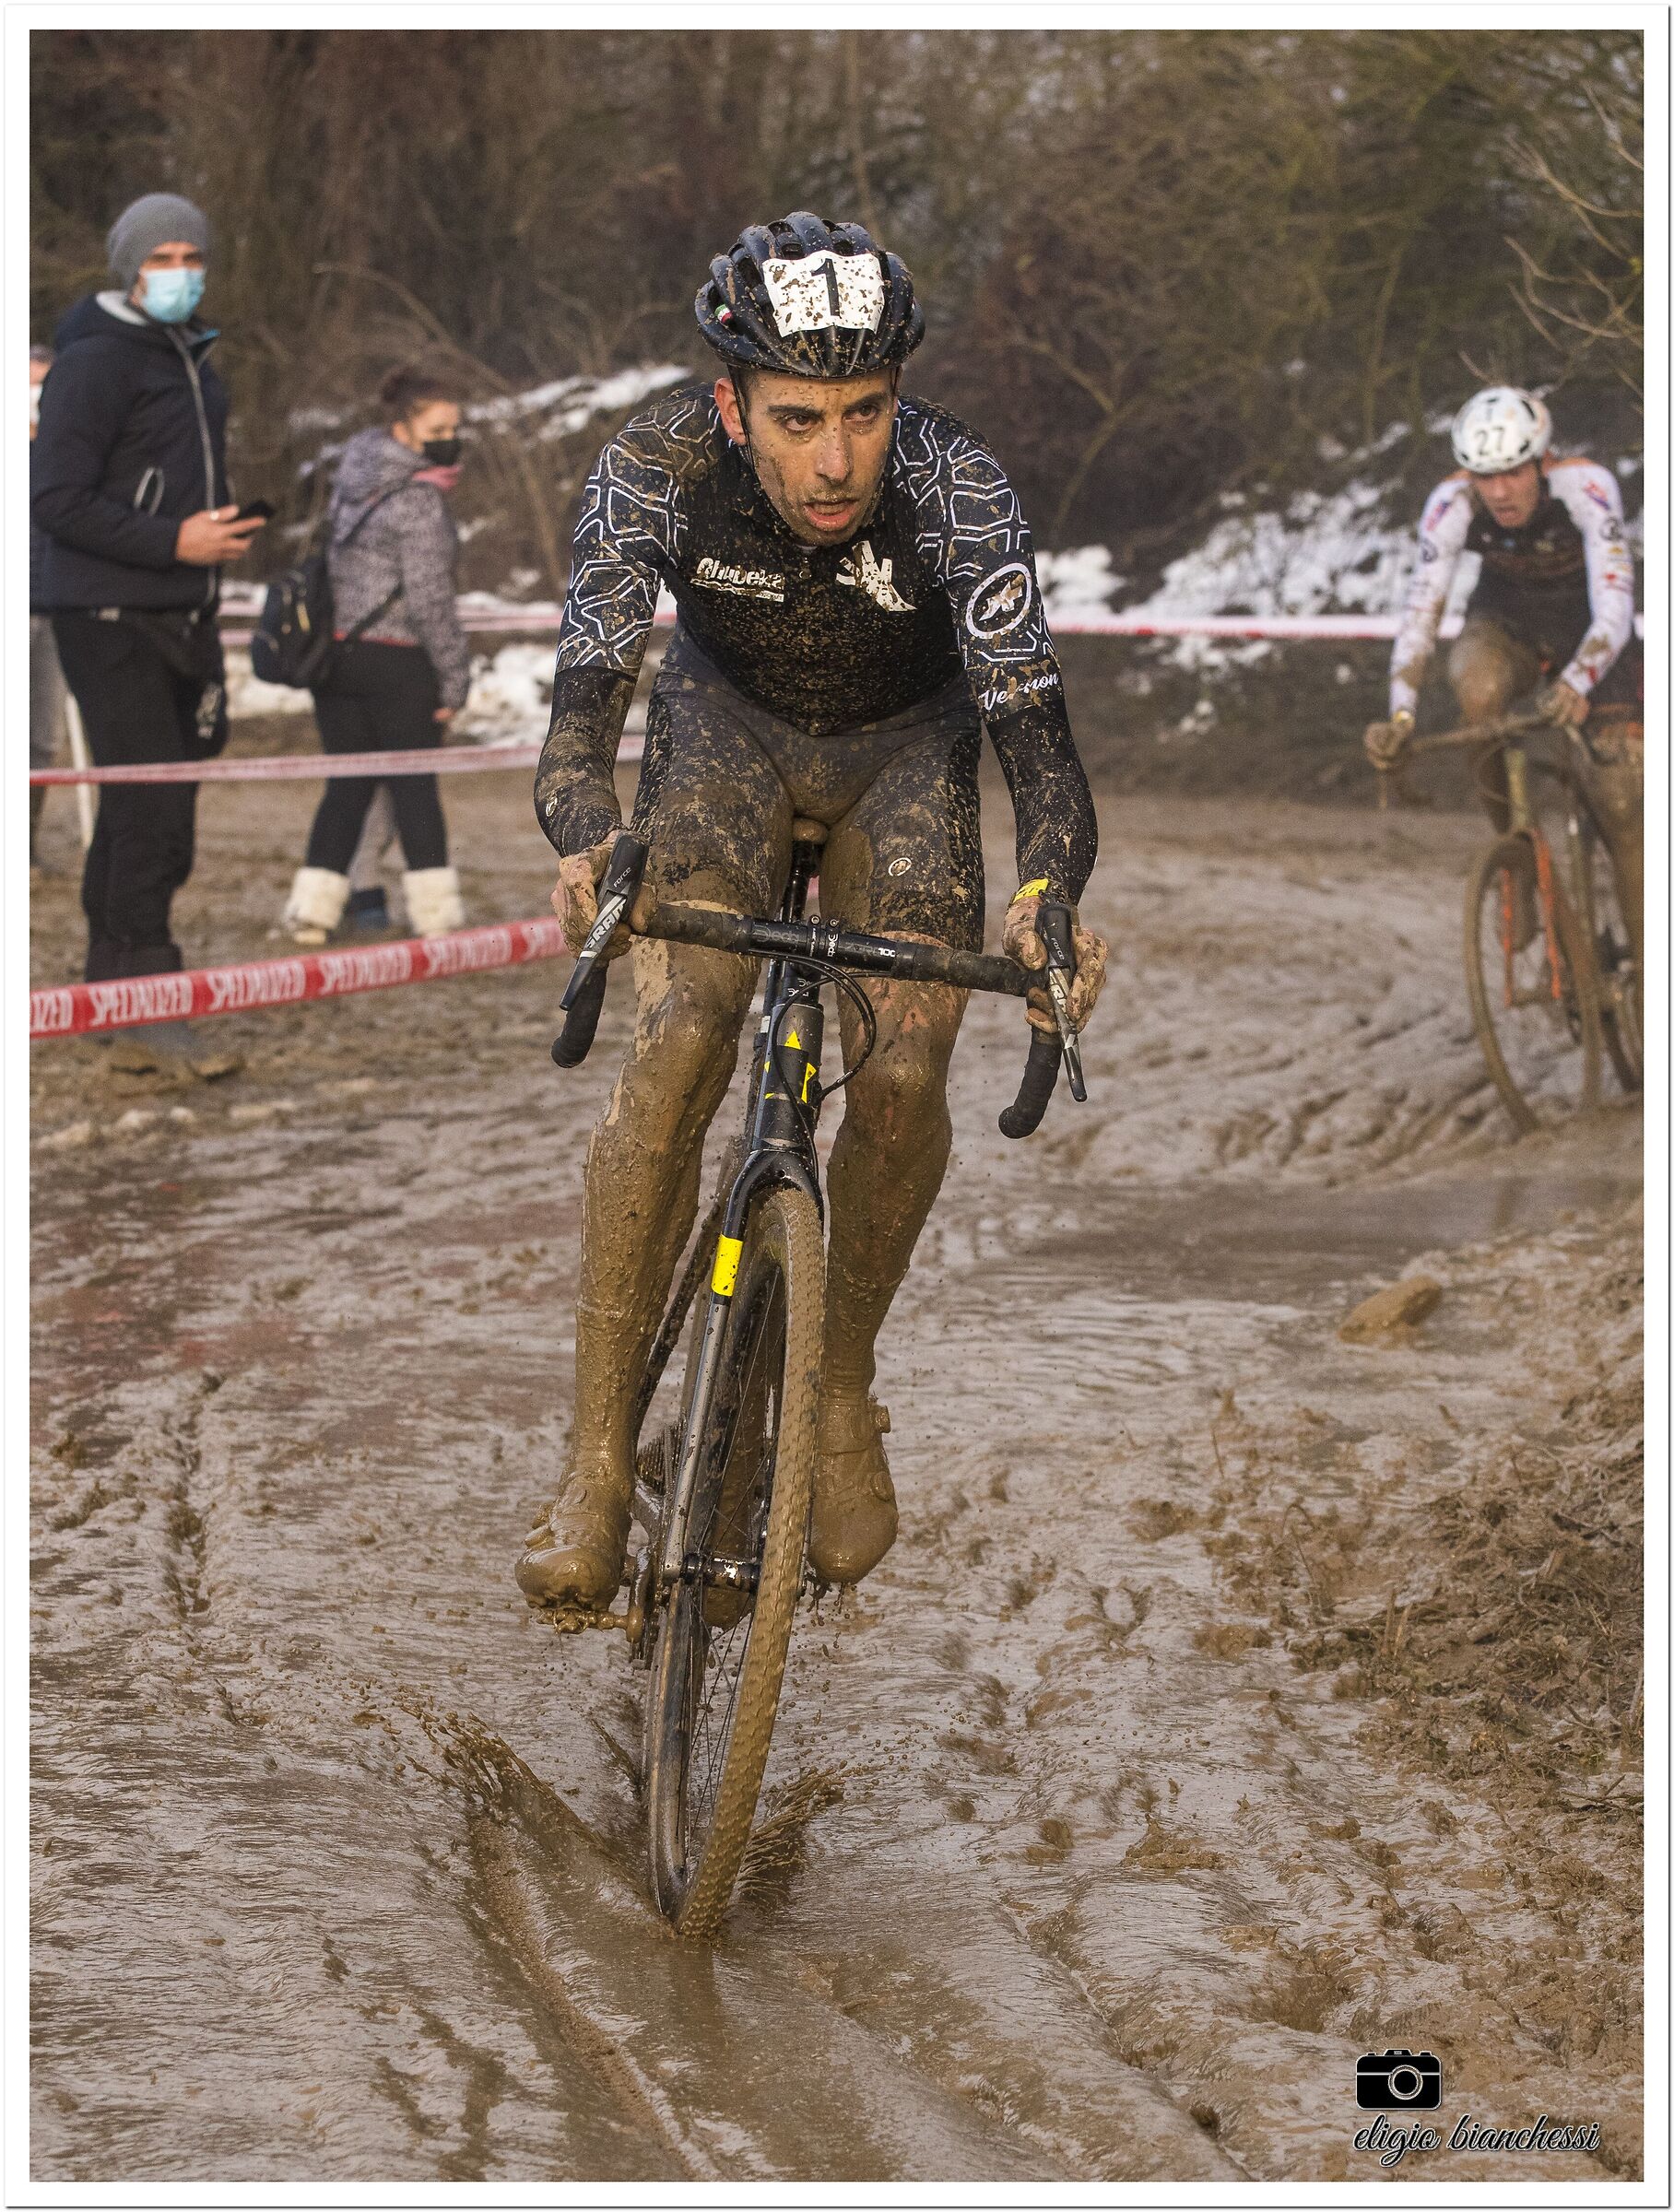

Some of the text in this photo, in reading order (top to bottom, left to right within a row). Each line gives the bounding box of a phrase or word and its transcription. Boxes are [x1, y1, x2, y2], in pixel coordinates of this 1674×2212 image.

[810, 257, 843, 318] 1
[1475, 427, 1505, 456] 27
[586, 899, 627, 948] SRAM
[88, 975, 194, 1028] SPECIALIZED
[206, 959, 307, 1012] SPECIALIZED
